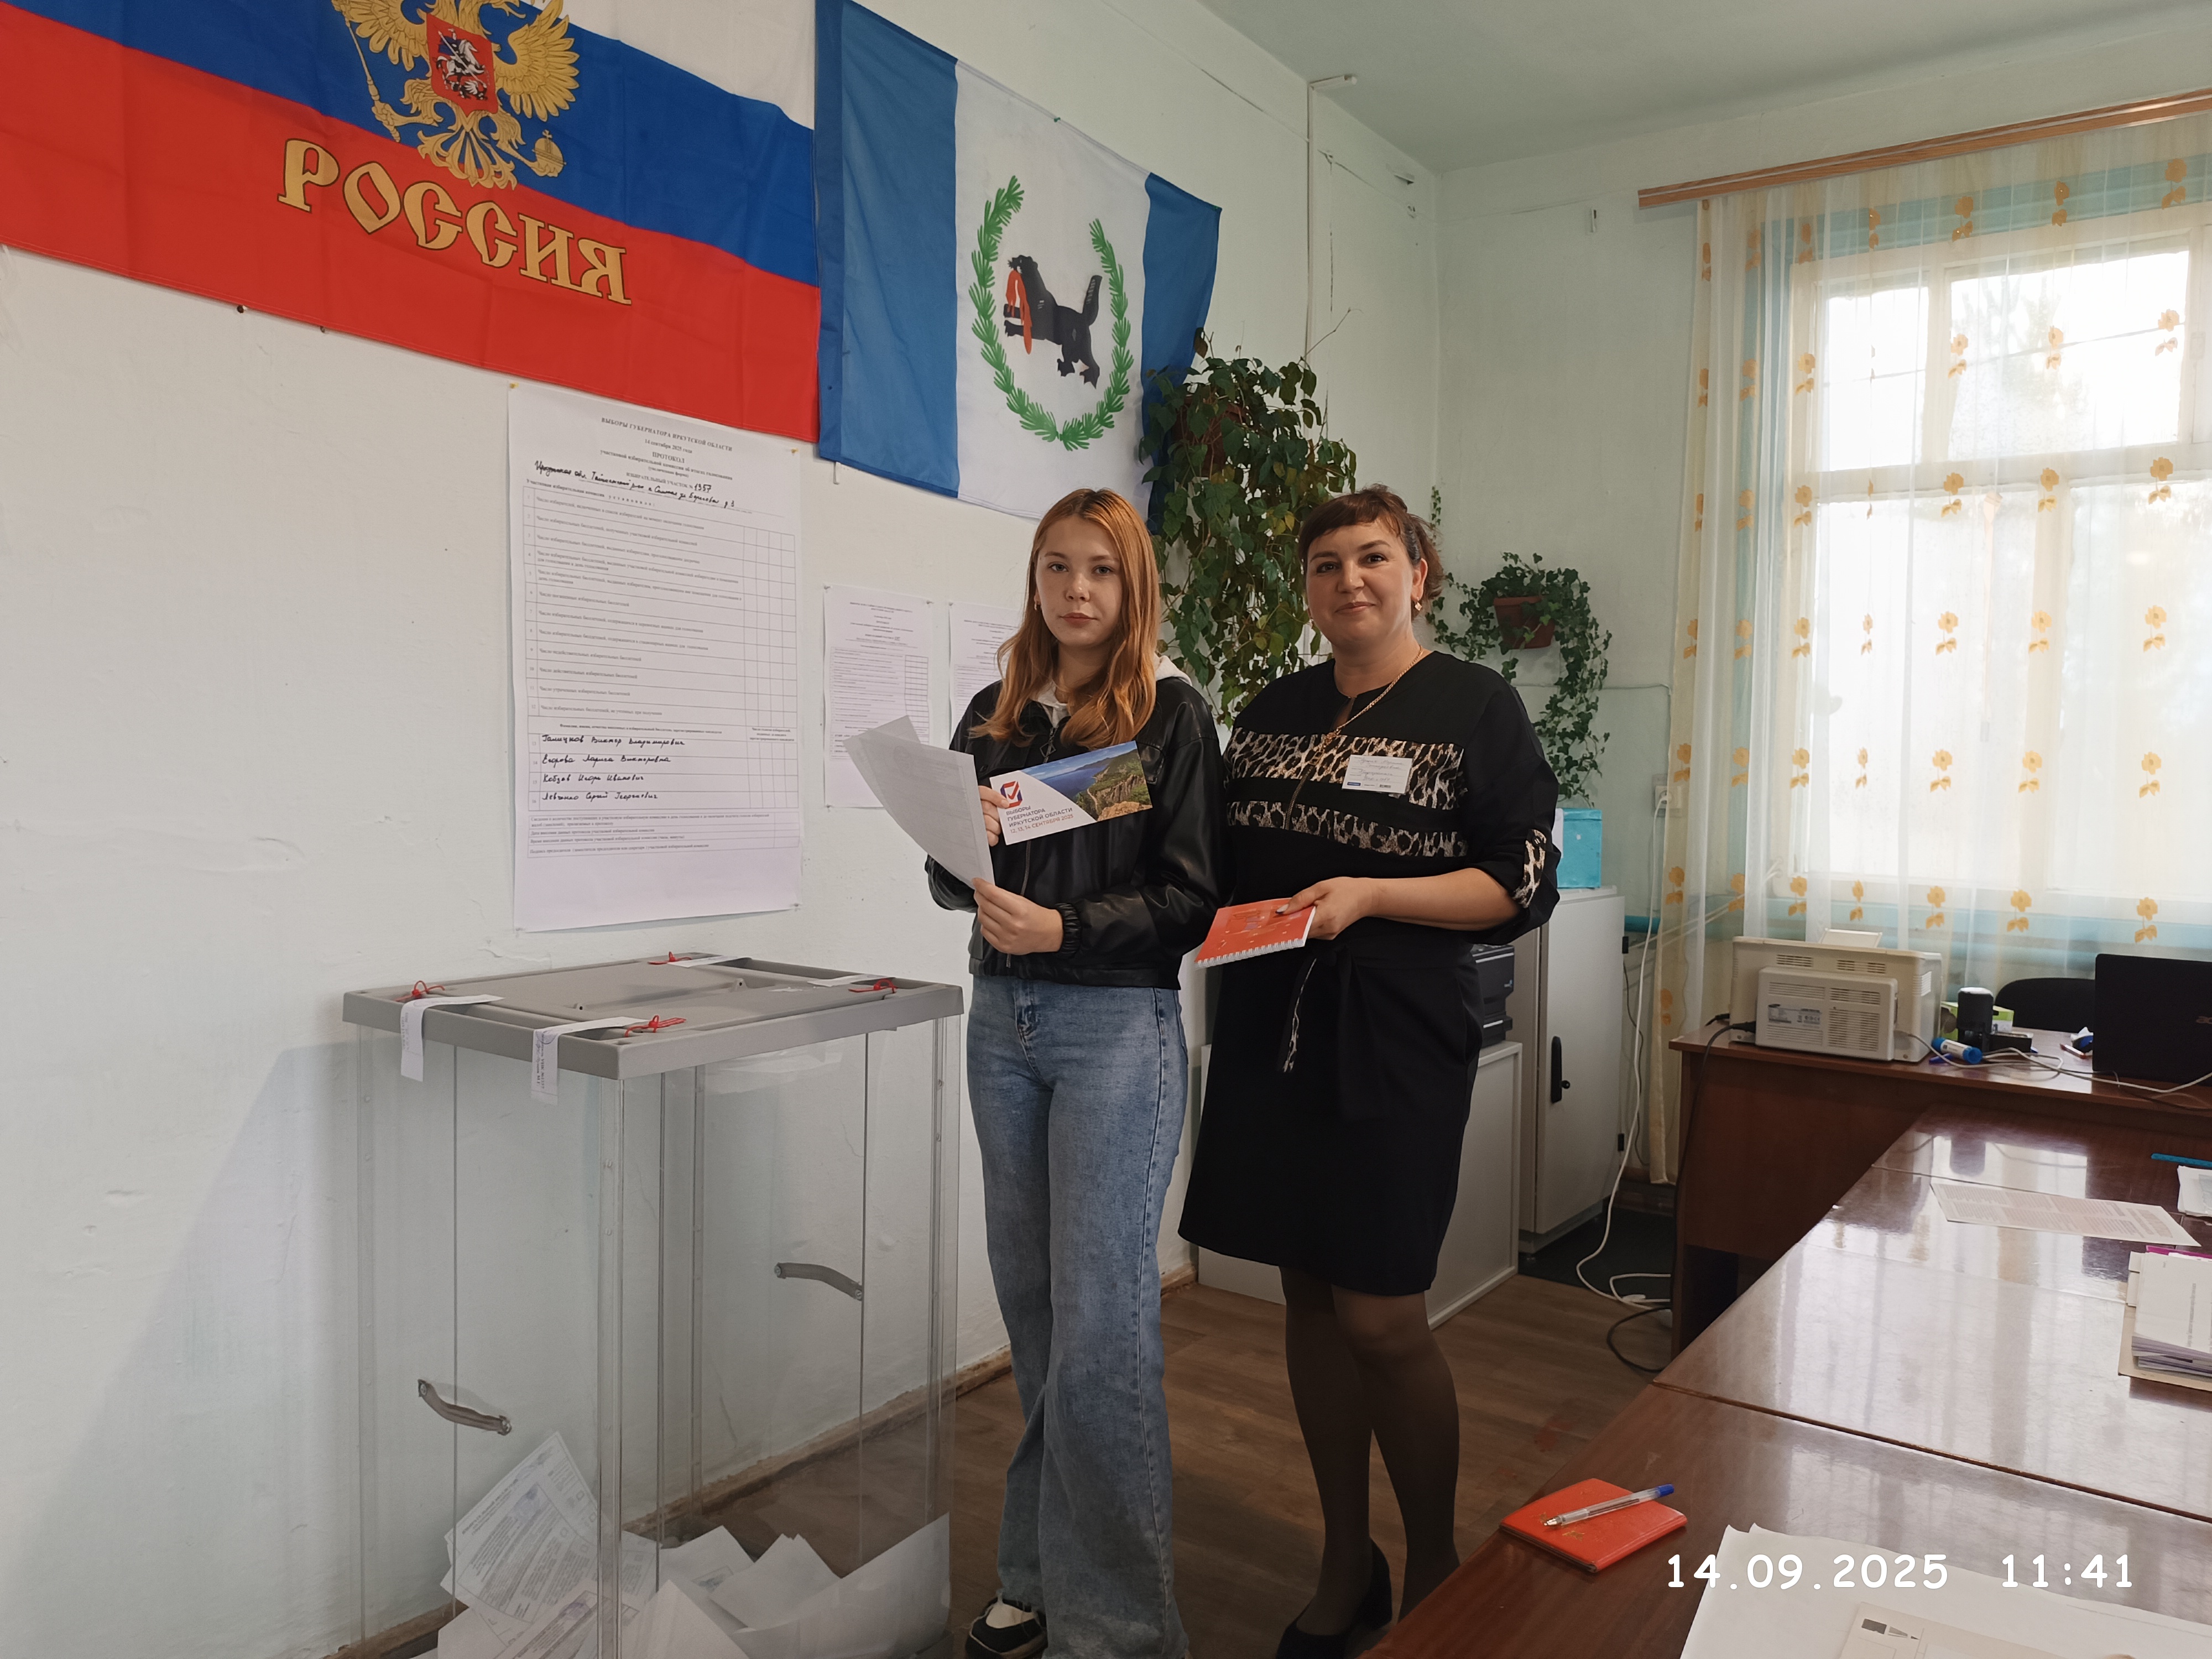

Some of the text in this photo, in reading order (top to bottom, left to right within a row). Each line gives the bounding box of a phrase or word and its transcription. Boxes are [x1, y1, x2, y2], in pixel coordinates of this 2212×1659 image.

[278, 138, 632, 306] РОССИЯ
[601, 418, 733, 452] ВЫБОРЫ ГУБЕРНАТОРА ИРКУТСКОЙ ОБЛАСТИ
[652, 451, 685, 463] ПРОТОКОЛ
[694, 483, 712, 493] 1357
[591, 736, 622, 747] Виктор
[542, 753, 576, 768] Егорова
[583, 754, 614, 768] Лариса
[1006, 806, 1031, 816] ВЫБОРЫ
[1007, 808, 1045, 821] ГУБЕРНАТОРА
[1009, 807, 1073, 827] ИРКУТСКОЙ ОБЛАСТИ
[1032, 817, 1061, 828] СЕНТЯБРЯ
